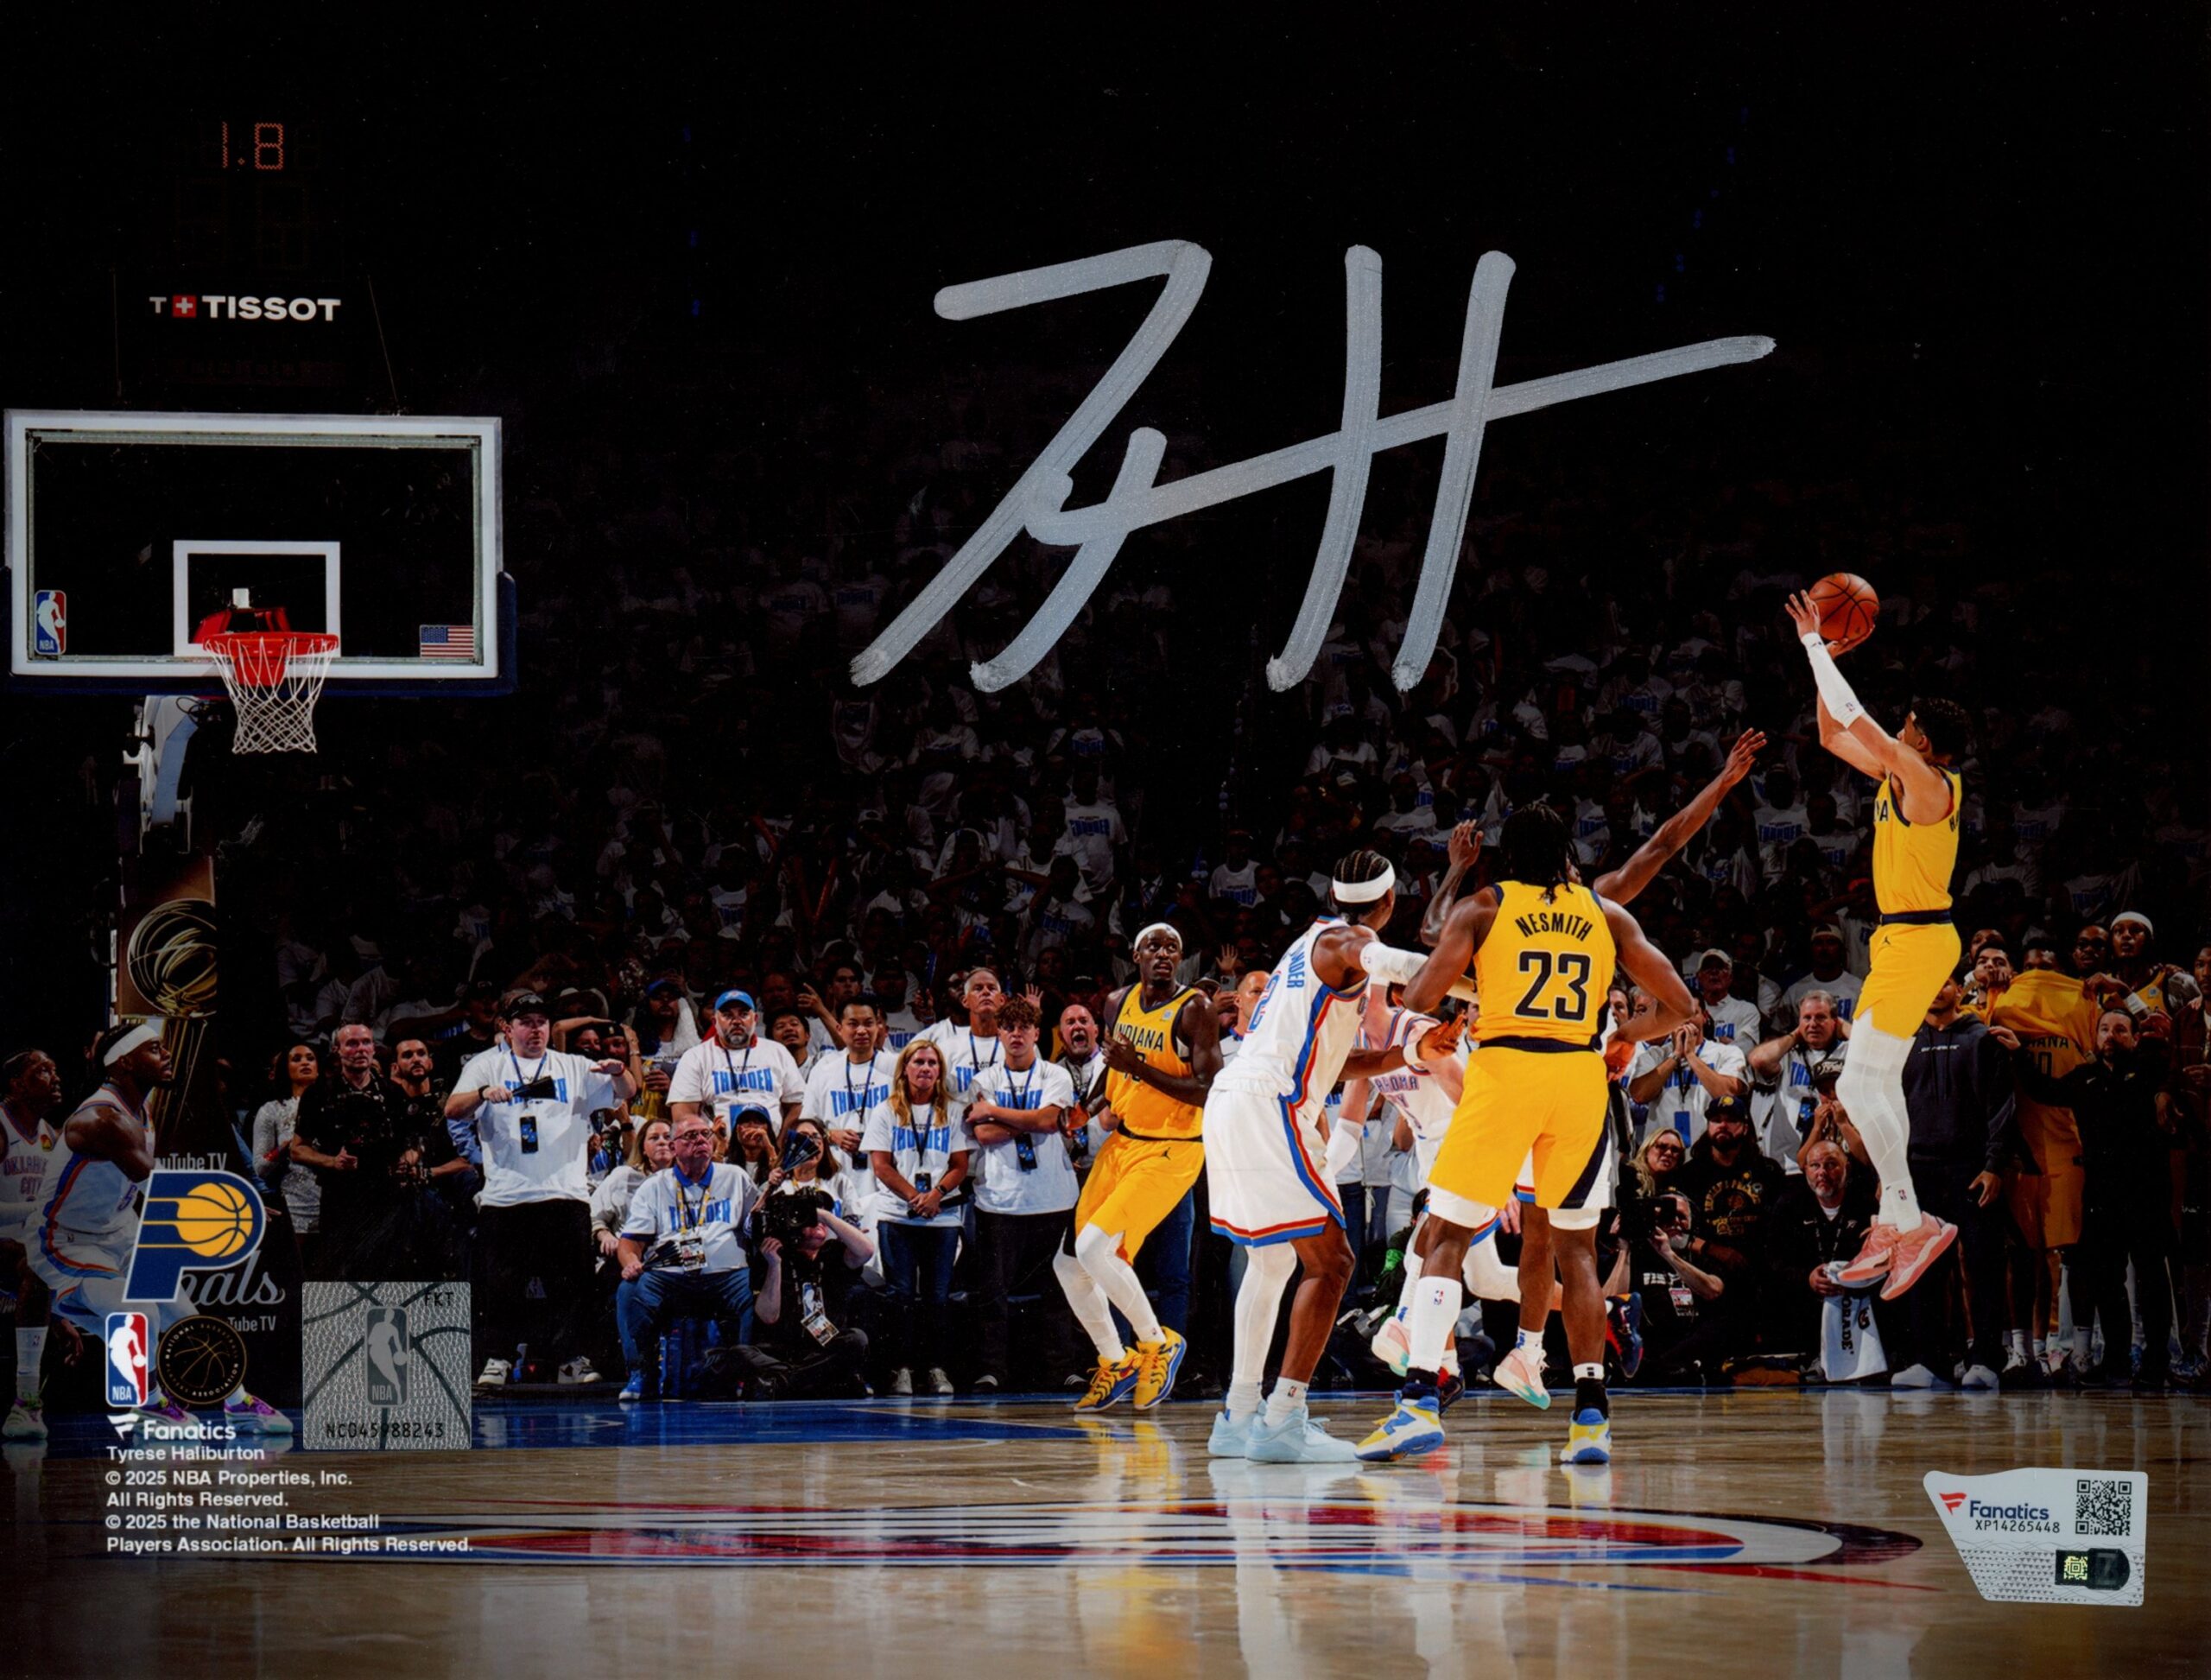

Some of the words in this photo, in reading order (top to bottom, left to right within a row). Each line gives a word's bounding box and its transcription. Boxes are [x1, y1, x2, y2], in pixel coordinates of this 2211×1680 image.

[222, 122, 284, 169] 1.8
[202, 295, 341, 321] TISSOT
[1515, 912, 1593, 942] NESMITH
[1515, 950, 1591, 1021] 23
[207, 1152, 227, 1170] TV
[259, 1315, 276, 1331] TV
[371, 1385, 393, 1401] NBA
[1969, 1500, 2050, 1520] Fanatics
[1975, 1519, 2062, 1533] XP14265448
